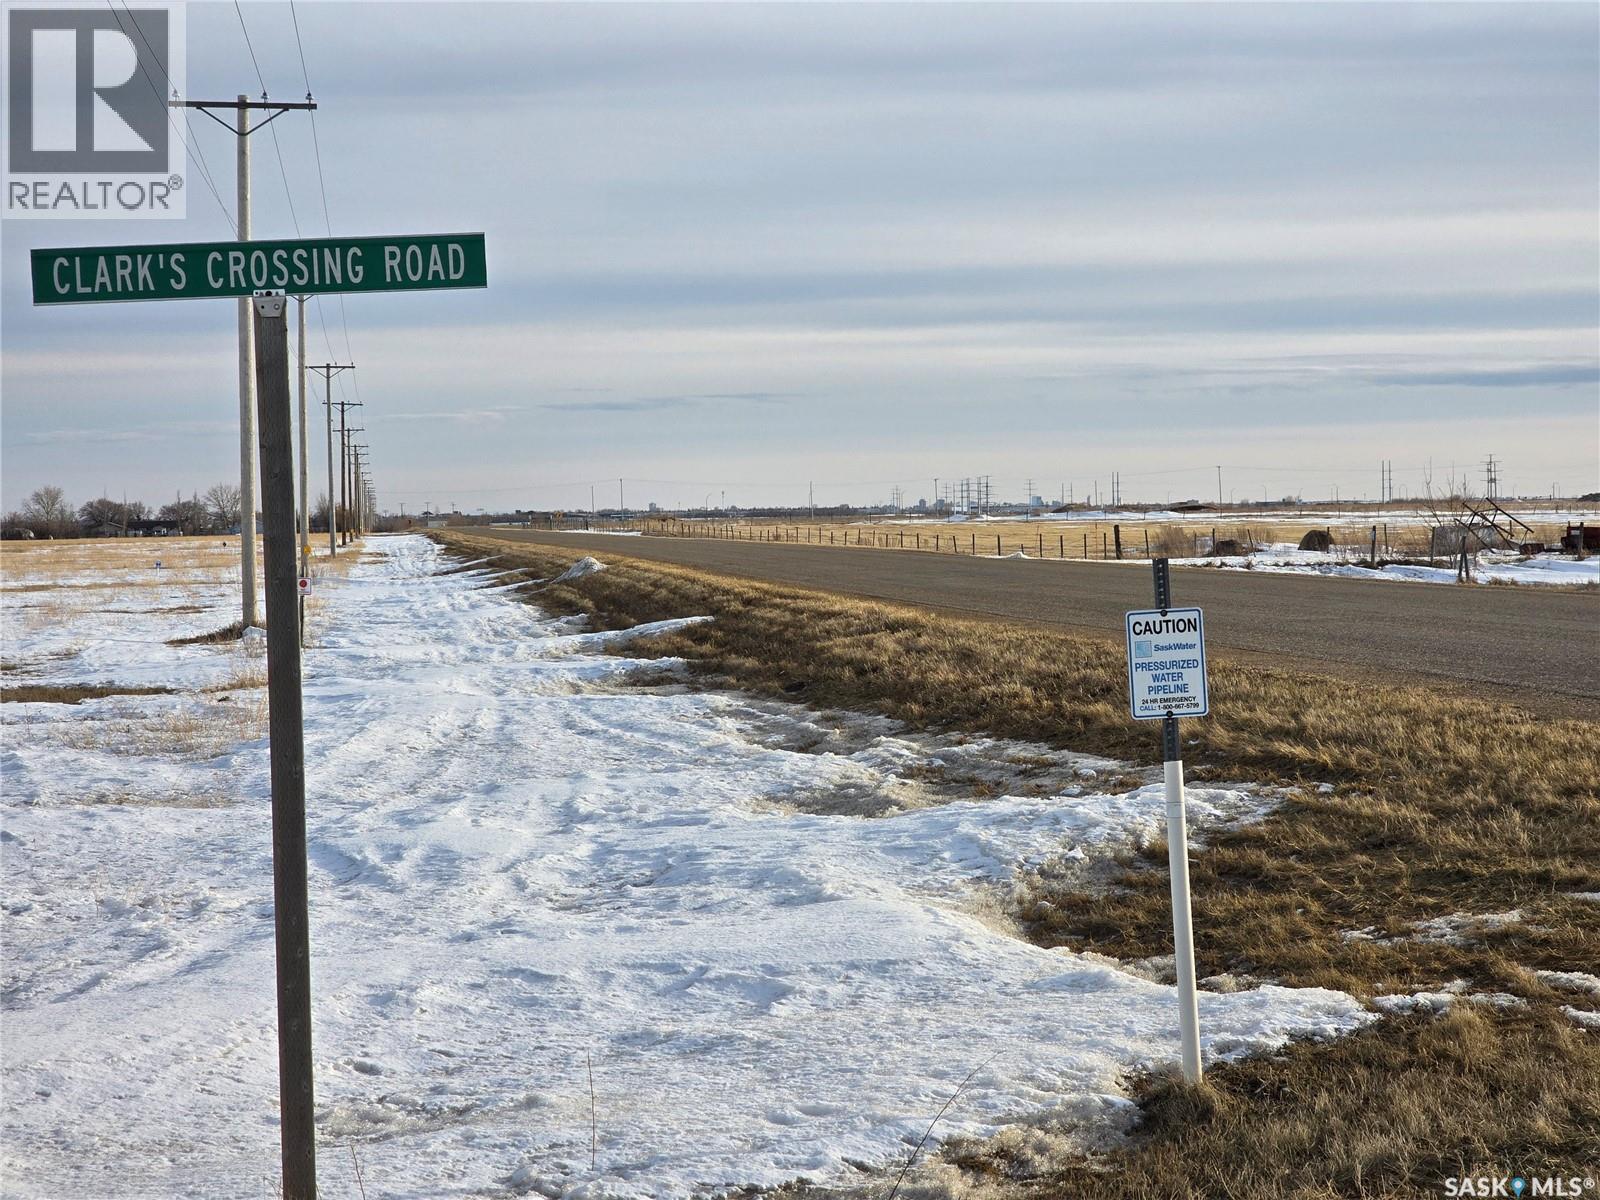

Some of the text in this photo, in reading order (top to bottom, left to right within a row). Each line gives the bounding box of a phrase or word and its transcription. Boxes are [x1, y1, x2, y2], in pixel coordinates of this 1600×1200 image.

[53, 243, 465, 295] CLARK'S CROSSING ROAD
[1132, 617, 1198, 636] CAUTION
[1153, 642, 1197, 652] SaskWater
[1135, 659, 1199, 672] PRESSURIZED
[1151, 672, 1184, 683] WATER
[1148, 684, 1189, 695] PIPELINE
[1159, 696, 1197, 704] EMERGENCY
